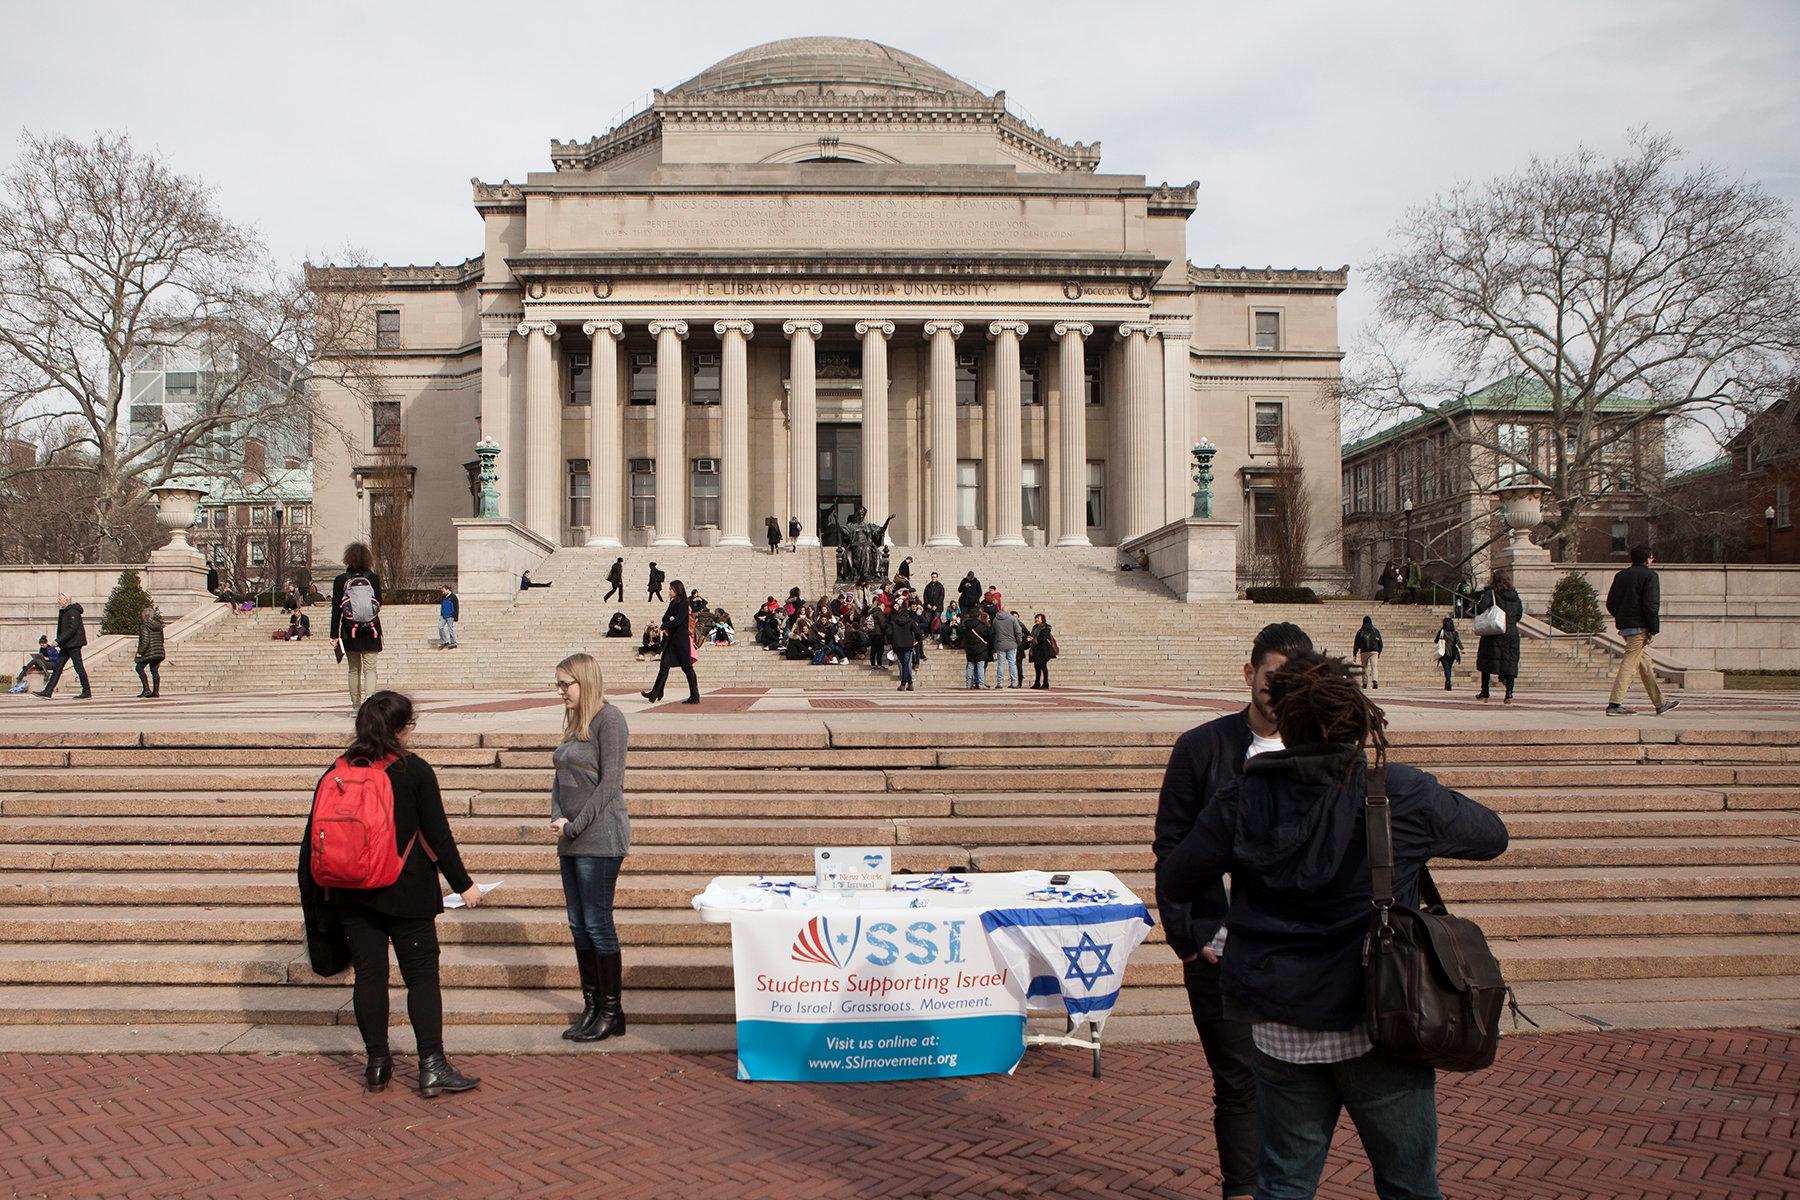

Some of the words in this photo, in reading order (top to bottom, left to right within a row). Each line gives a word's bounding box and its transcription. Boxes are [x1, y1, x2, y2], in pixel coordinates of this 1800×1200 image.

[661, 200, 698, 209] KING'S
[703, 200, 755, 209] COLLEGE
[762, 200, 817, 209] FOUNDED
[823, 201, 834, 210] IN
[841, 201, 864, 210] THE
[871, 201, 926, 210] PROVINCE
[932, 201, 948, 210] OF
[953, 201, 977, 210] NEW
[984, 201, 1017, 210] YORK
[686, 283, 714, 296] THE
[723, 283, 785, 296] LIBRARY
[791, 283, 810, 296] OF
[819, 283, 897, 296] COLUMBIA
[903, 283, 992, 296] UNIVERSITY
[840, 873, 860, 881] New
[861, 873, 884, 881] York
[866, 920, 965, 966] SSI
[756, 974, 840, 993] Students
[846, 973, 951, 998] Supporting
[956, 968, 1008, 989] Israel
[771, 1000, 792, 1013] Pro
[796, 1001, 835, 1014] Israel.
[841, 1000, 914, 1013] Grassroots.
[920, 997, 993, 1012] Movement.
[826, 1036, 855, 1050] Visit
[859, 1040, 874, 1049] us
[877, 1035, 918, 1049] online
[921, 1035, 940, 1047] at:
[809, 1053, 958, 1070] www.SSImovement.org
